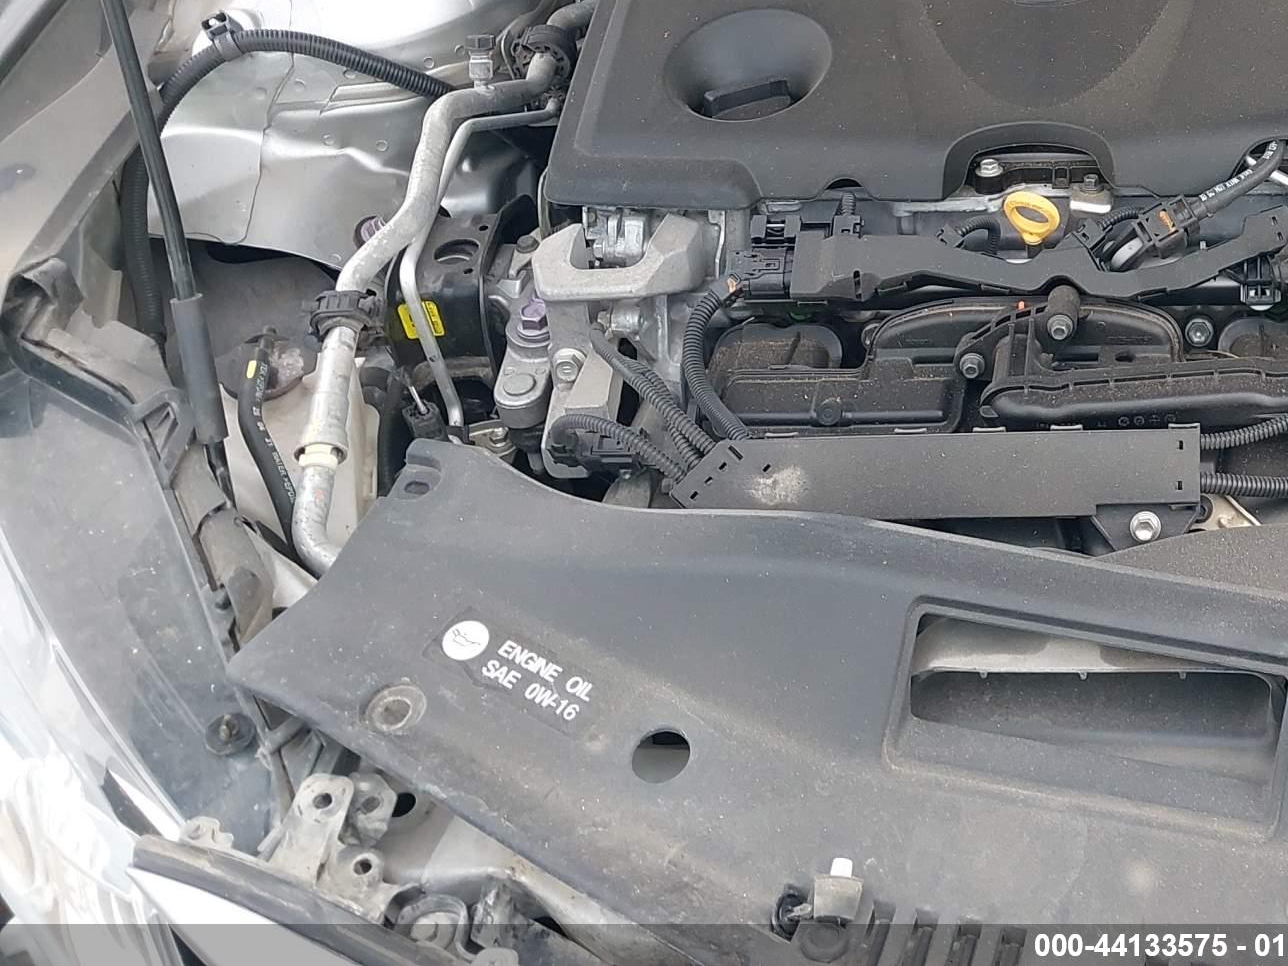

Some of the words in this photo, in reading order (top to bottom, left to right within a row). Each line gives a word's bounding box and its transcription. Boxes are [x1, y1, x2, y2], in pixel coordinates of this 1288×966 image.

[481, 659, 522, 690] SAE
[524, 683, 580, 721] 0W-16
[497, 639, 563, 683] ENGINE
[565, 676, 593, 702] OIL
